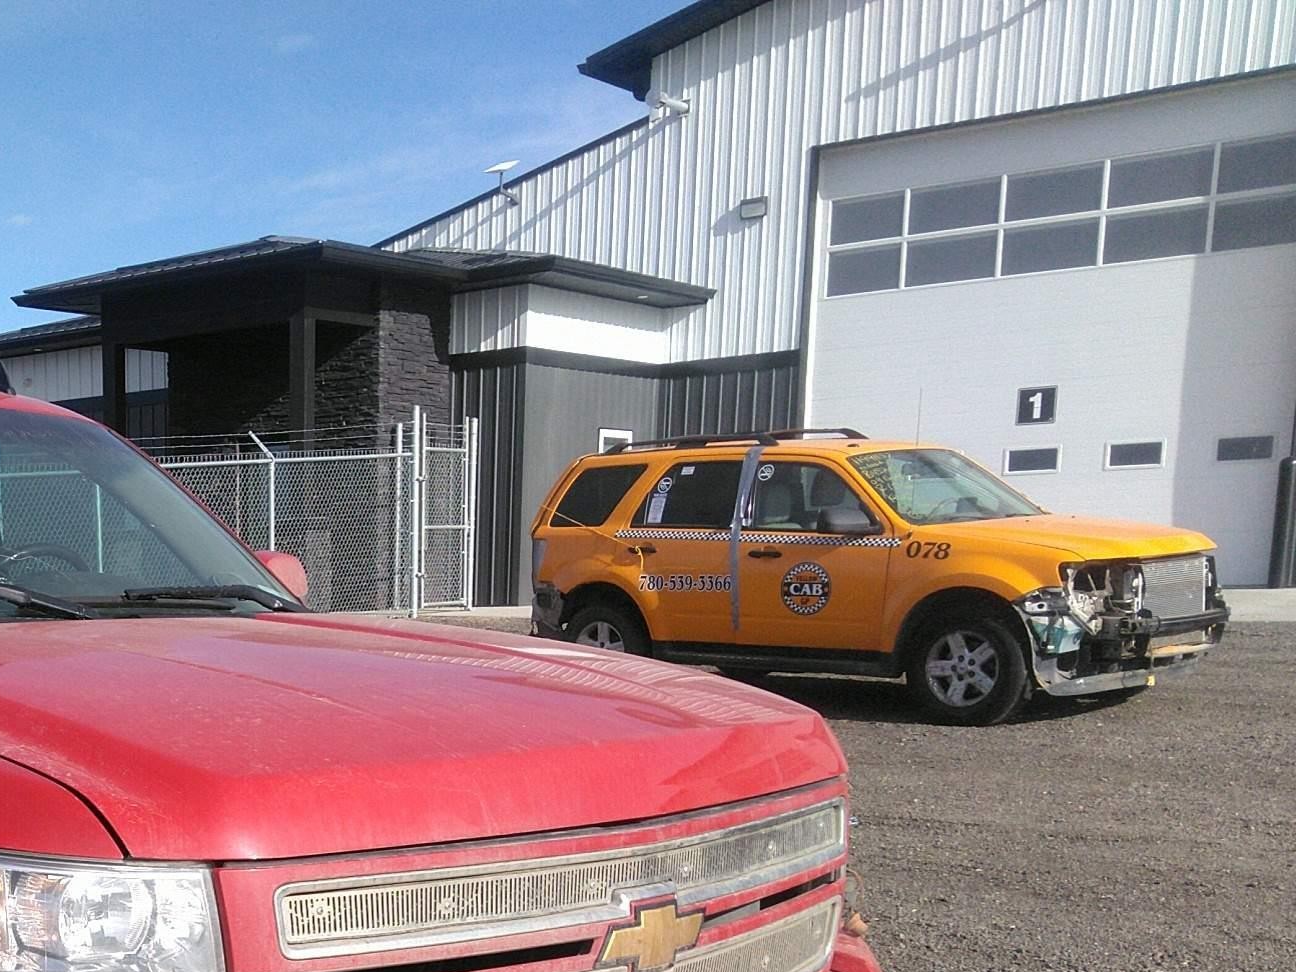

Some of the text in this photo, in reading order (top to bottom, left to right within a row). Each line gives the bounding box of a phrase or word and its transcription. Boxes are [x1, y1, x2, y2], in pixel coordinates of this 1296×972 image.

[1029, 392, 1042, 419] 1
[906, 541, 951, 560] 078
[639, 574, 732, 592] 780-539-3366
[789, 583, 823, 596] CAB
